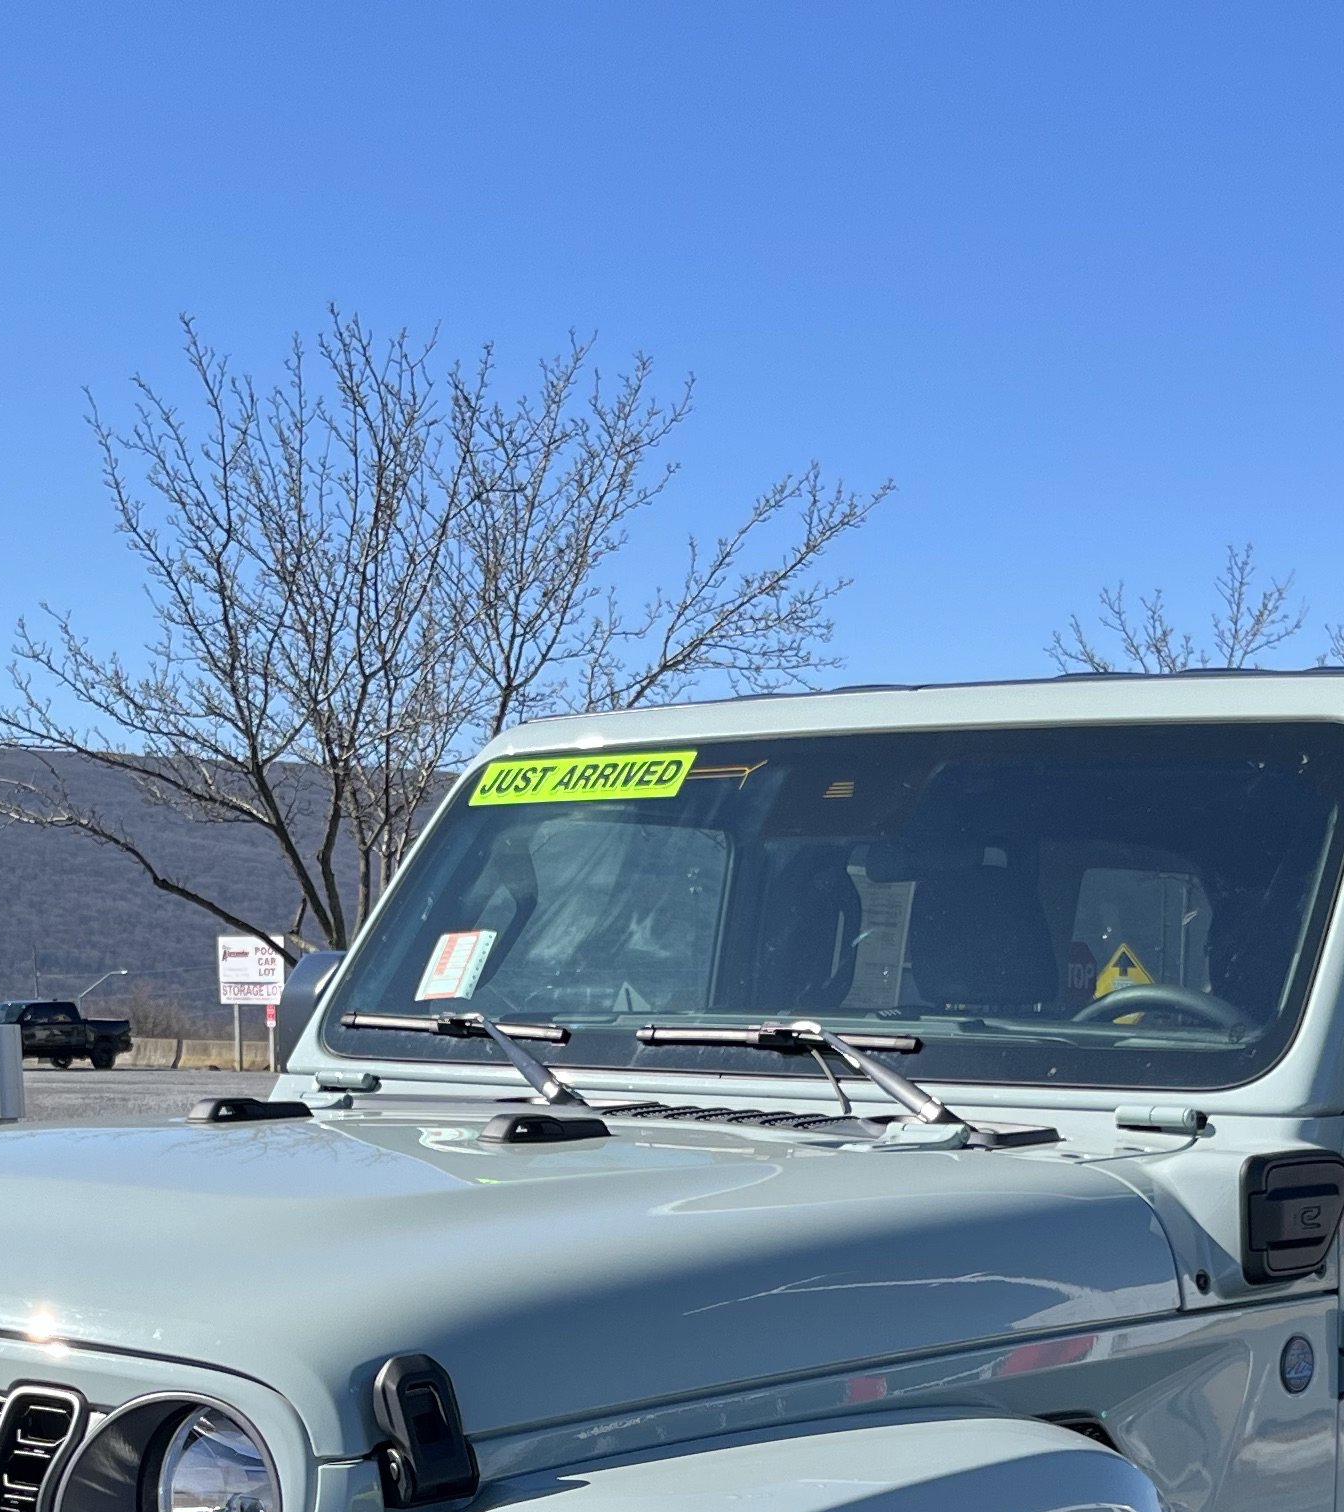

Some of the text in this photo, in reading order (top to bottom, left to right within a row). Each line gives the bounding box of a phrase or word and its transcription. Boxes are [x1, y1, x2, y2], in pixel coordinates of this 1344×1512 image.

[479, 760, 684, 795] JUST ARRIVED
[257, 958, 276, 966] CAR
[258, 968, 276, 976] LOT
[1067, 963, 1095, 989] TOP
[222, 985, 283, 997] STORAGE LOT
